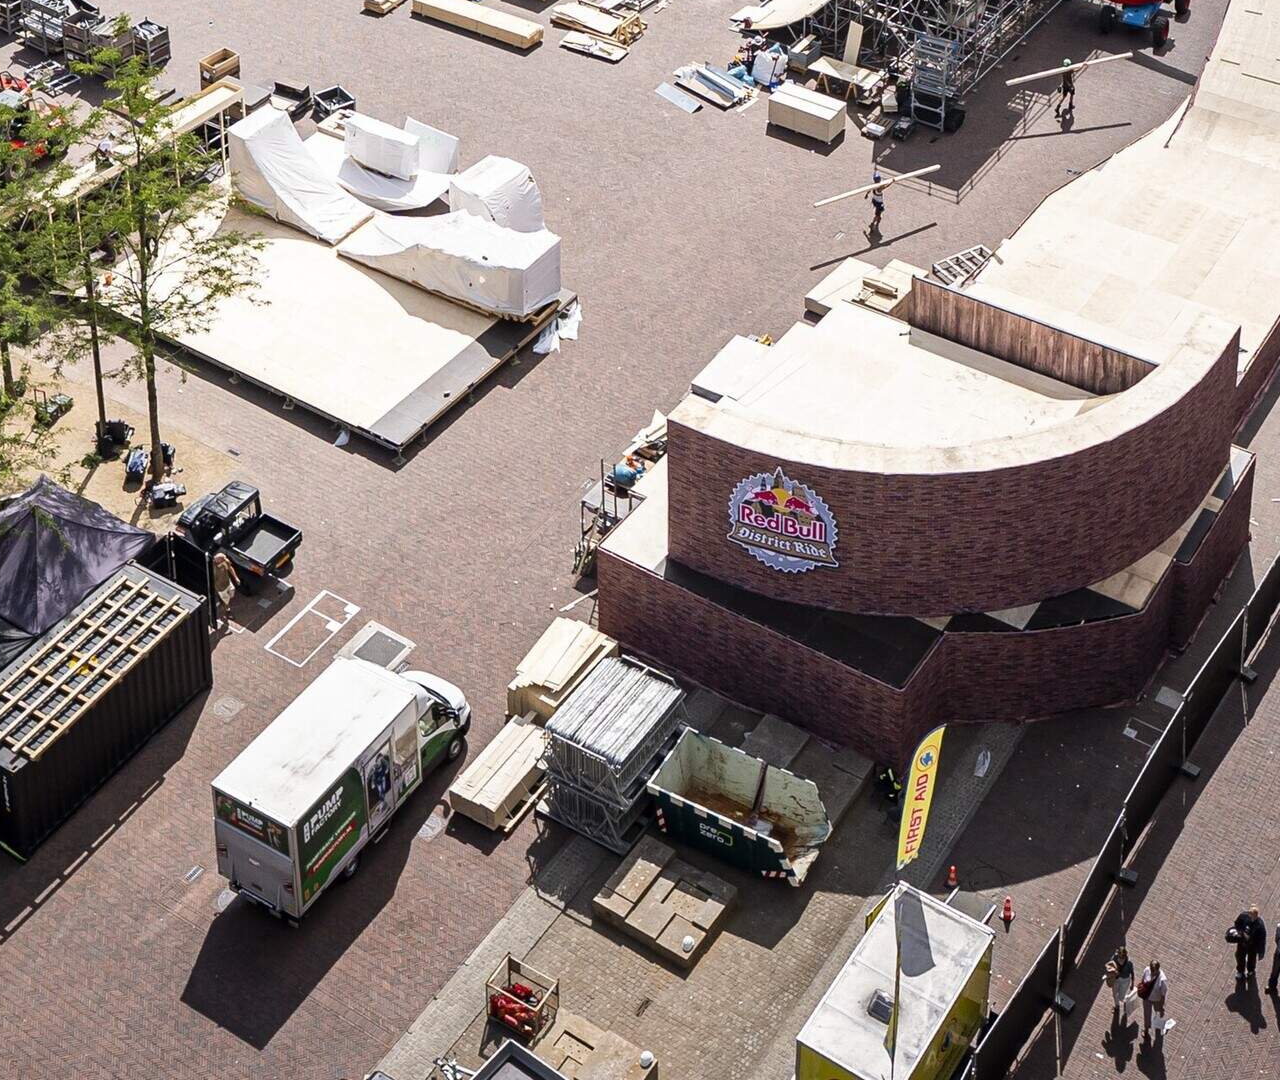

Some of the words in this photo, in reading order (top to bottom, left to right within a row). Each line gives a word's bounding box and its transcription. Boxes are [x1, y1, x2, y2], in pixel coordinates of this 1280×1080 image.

[739, 503, 782, 533] Red
[782, 515, 826, 543] Bull
[738, 527, 791, 551] District
[792, 542, 827, 558] Ride
[310, 785, 344, 828] PUMP
[311, 800, 342, 836] FACTORY
[904, 808, 924, 855] FIRST
[914, 773, 929, 801] AID
[699, 822, 717, 833] pre
[700, 830, 724, 844] zero
